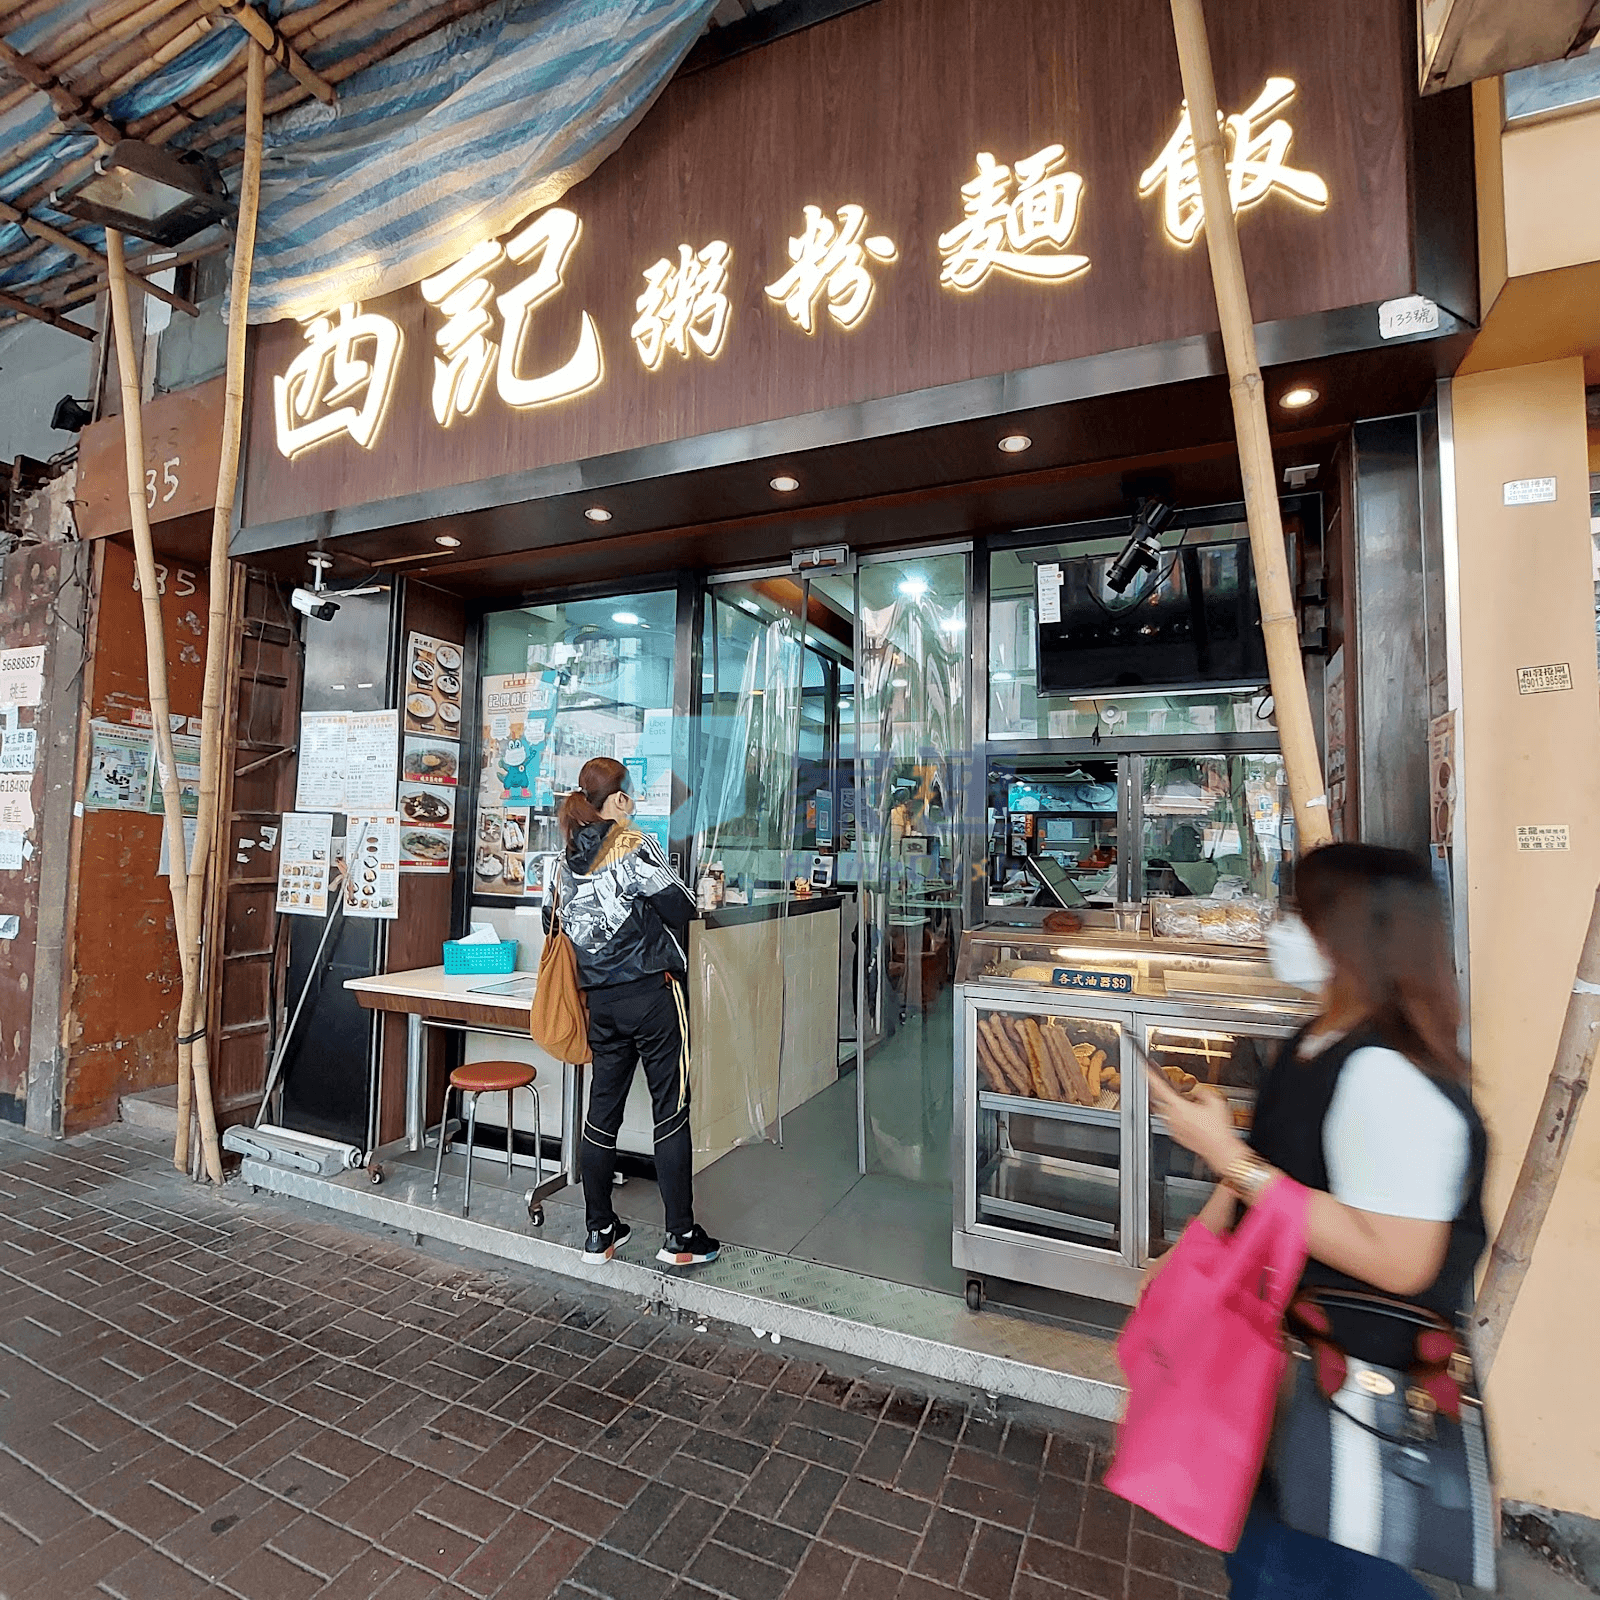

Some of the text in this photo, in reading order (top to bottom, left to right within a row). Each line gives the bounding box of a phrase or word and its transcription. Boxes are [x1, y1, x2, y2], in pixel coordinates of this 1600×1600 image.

[1389, 307, 1434, 328] 133號
[2, 655, 41, 671] 56888857
[649, 719, 667, 727] Uber
[649, 728, 667, 736] Eats
